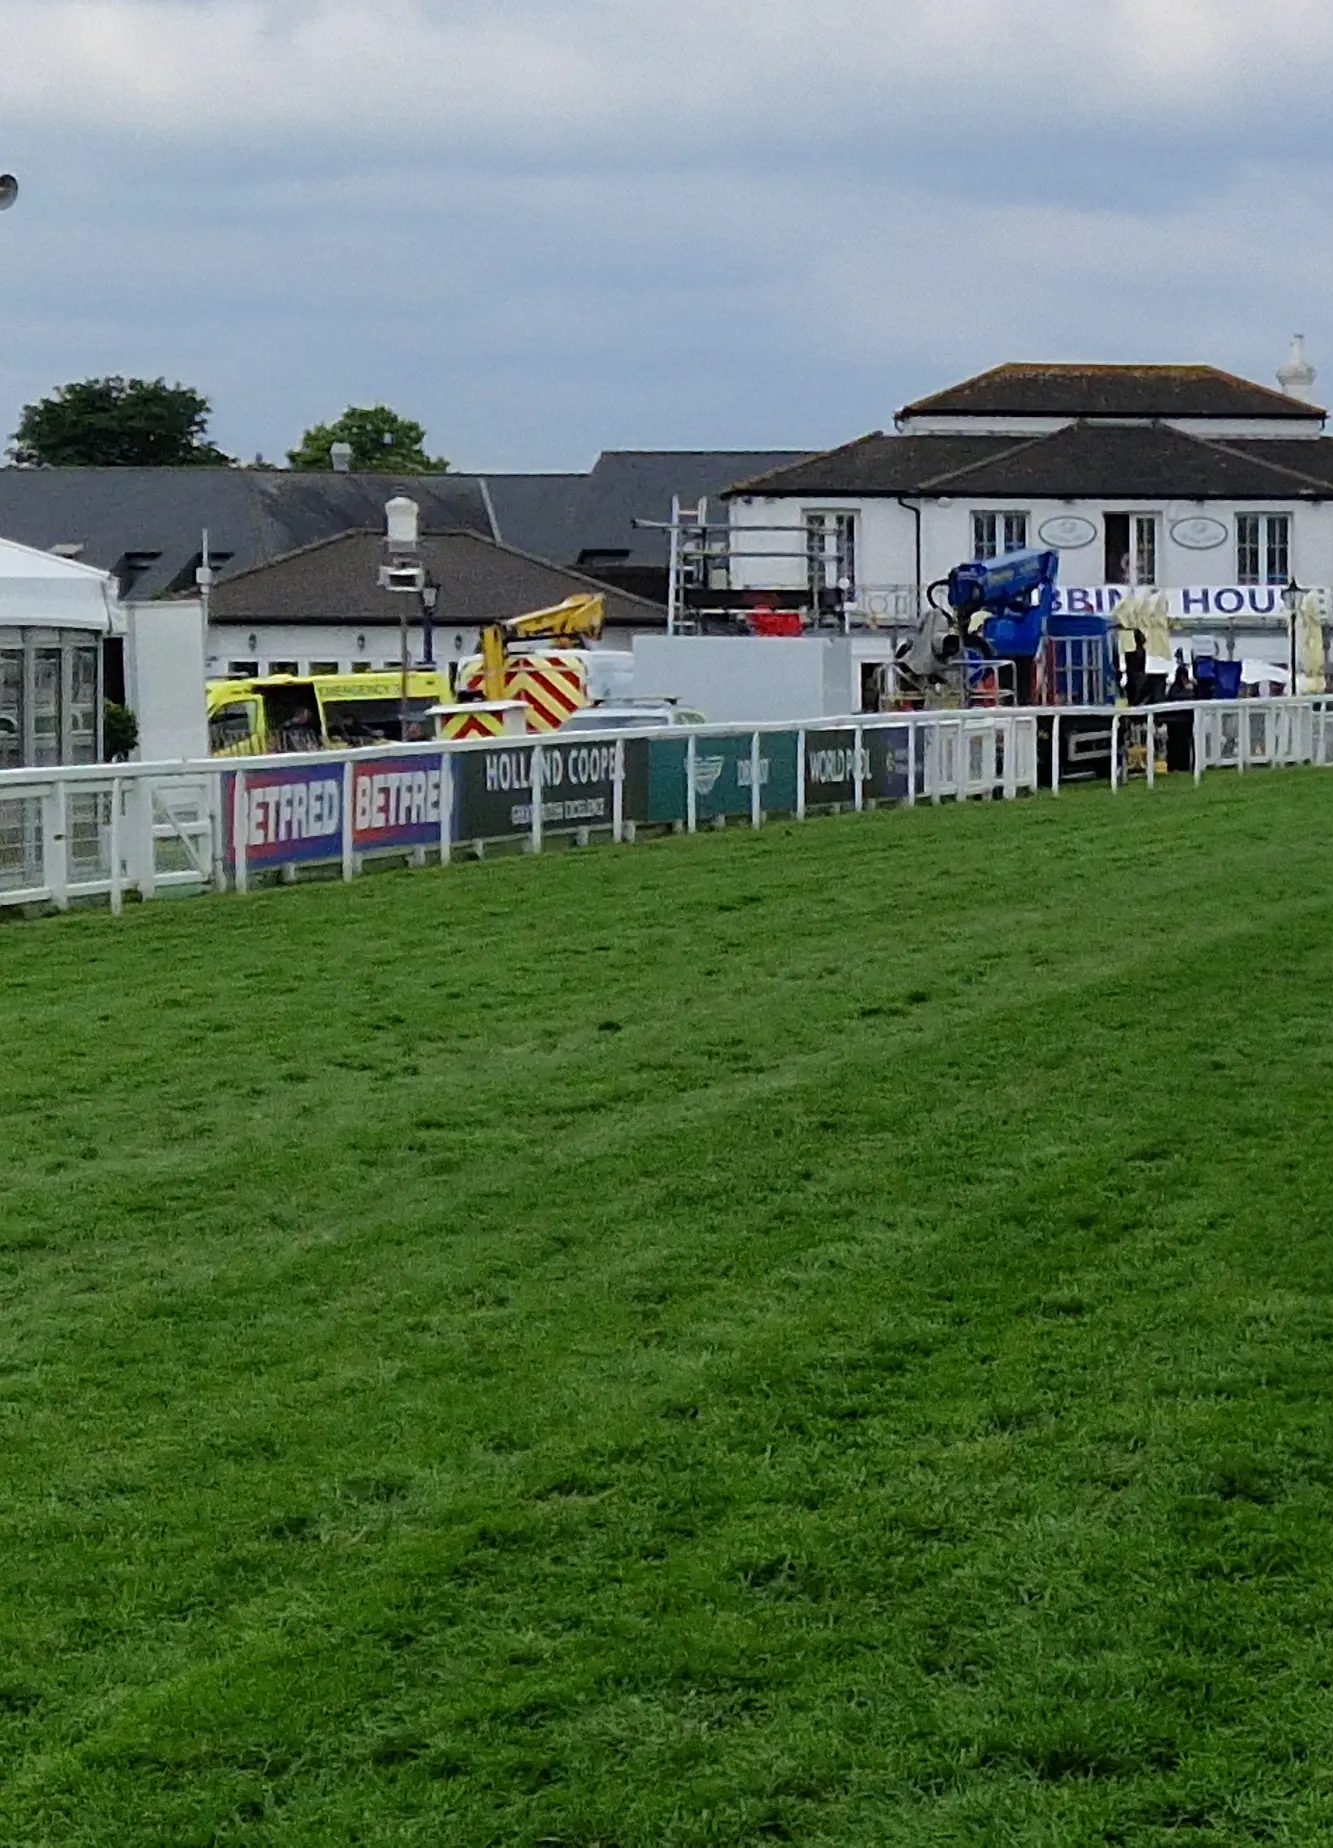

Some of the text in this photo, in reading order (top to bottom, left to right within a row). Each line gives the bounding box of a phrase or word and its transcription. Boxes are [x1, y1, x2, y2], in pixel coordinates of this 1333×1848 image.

[1050, 587, 1326, 615] BIN HOU
[809, 750, 845, 784] WORLD
[234, 779, 341, 847] ETFRED
[354, 769, 454, 831] BETFRE
